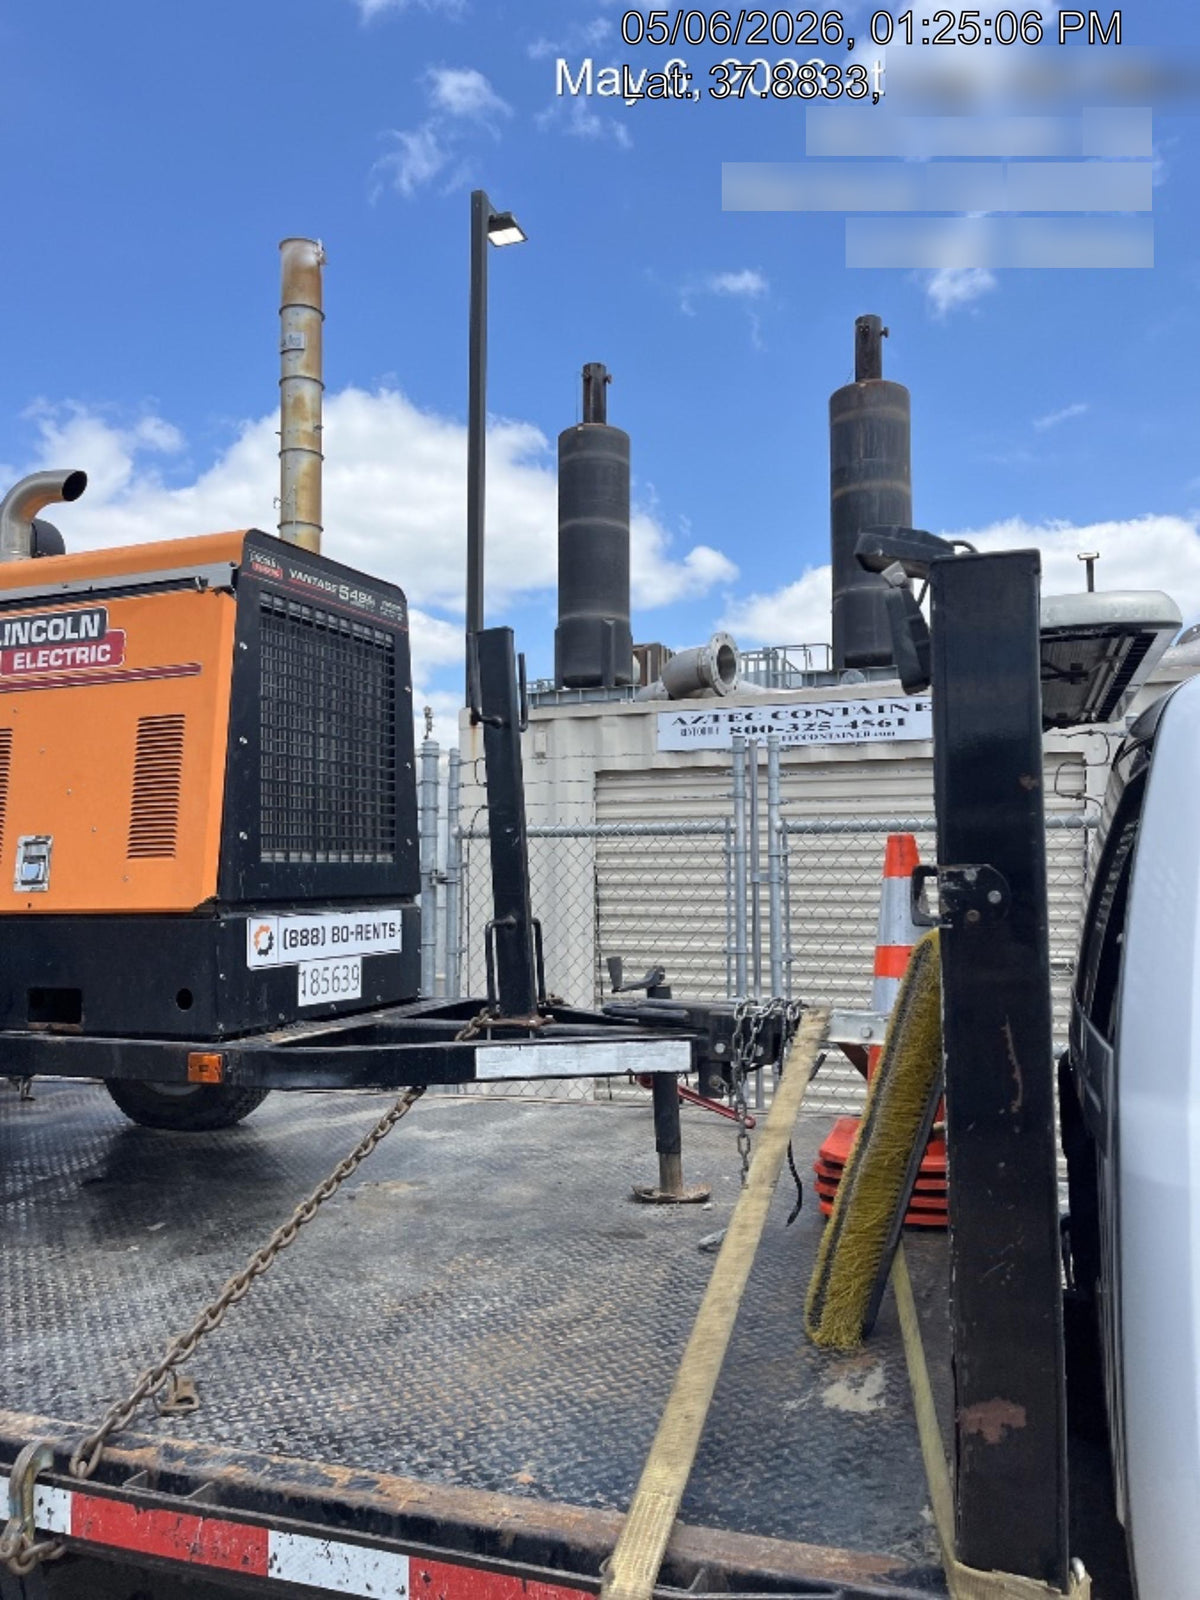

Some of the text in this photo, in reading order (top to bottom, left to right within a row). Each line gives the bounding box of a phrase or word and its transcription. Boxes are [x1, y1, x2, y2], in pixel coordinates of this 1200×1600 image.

[0, 614, 100, 646] INCOLN
[13, 644, 111, 671] ELECTRIC
[672, 711, 762, 726] AZTEC
[729, 717, 906, 735] 800-325-4561
[283, 925, 326, 950] (888)
[300, 964, 360, 997] 185639
